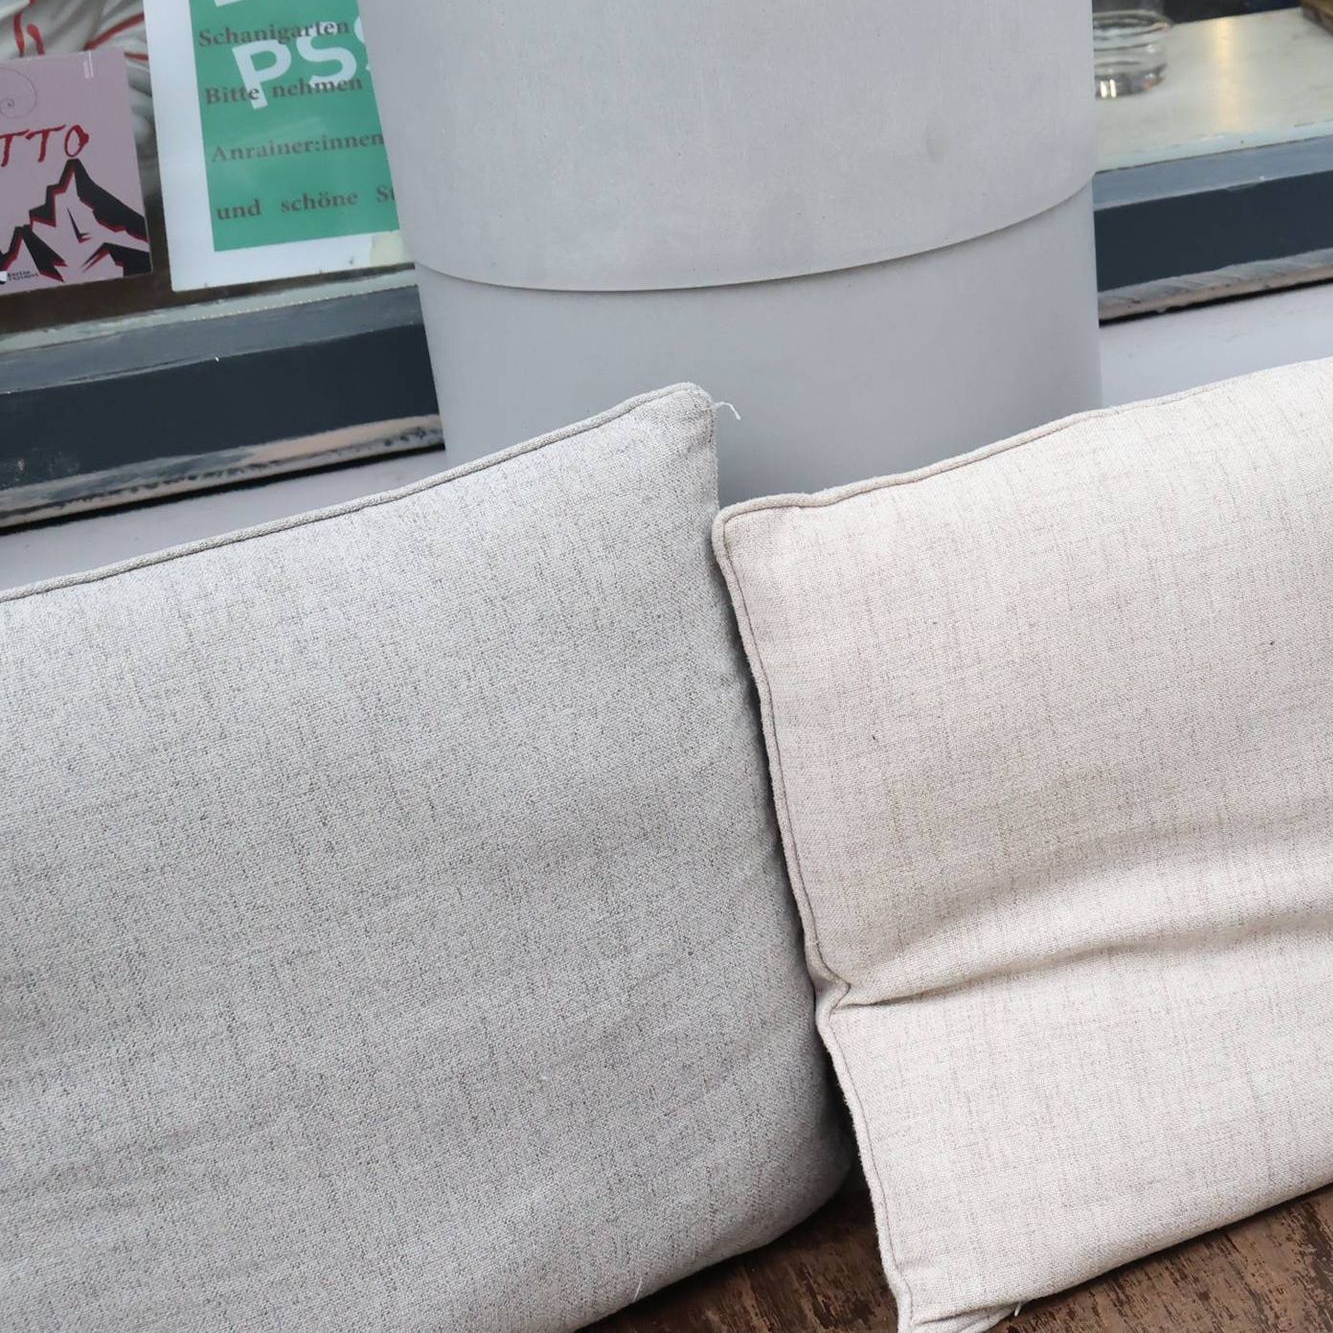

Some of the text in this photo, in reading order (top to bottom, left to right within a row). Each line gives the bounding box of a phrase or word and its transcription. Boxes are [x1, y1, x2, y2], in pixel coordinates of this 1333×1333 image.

[199, 20, 349, 47] Schanigarten
[232, 17, 370, 109] PS
[205, 76, 363, 105] Bitte nehmen
[212, 132, 384, 163] Anrainer:innen
[216, 198, 262, 220] und
[280, 191, 359, 213] schöne
